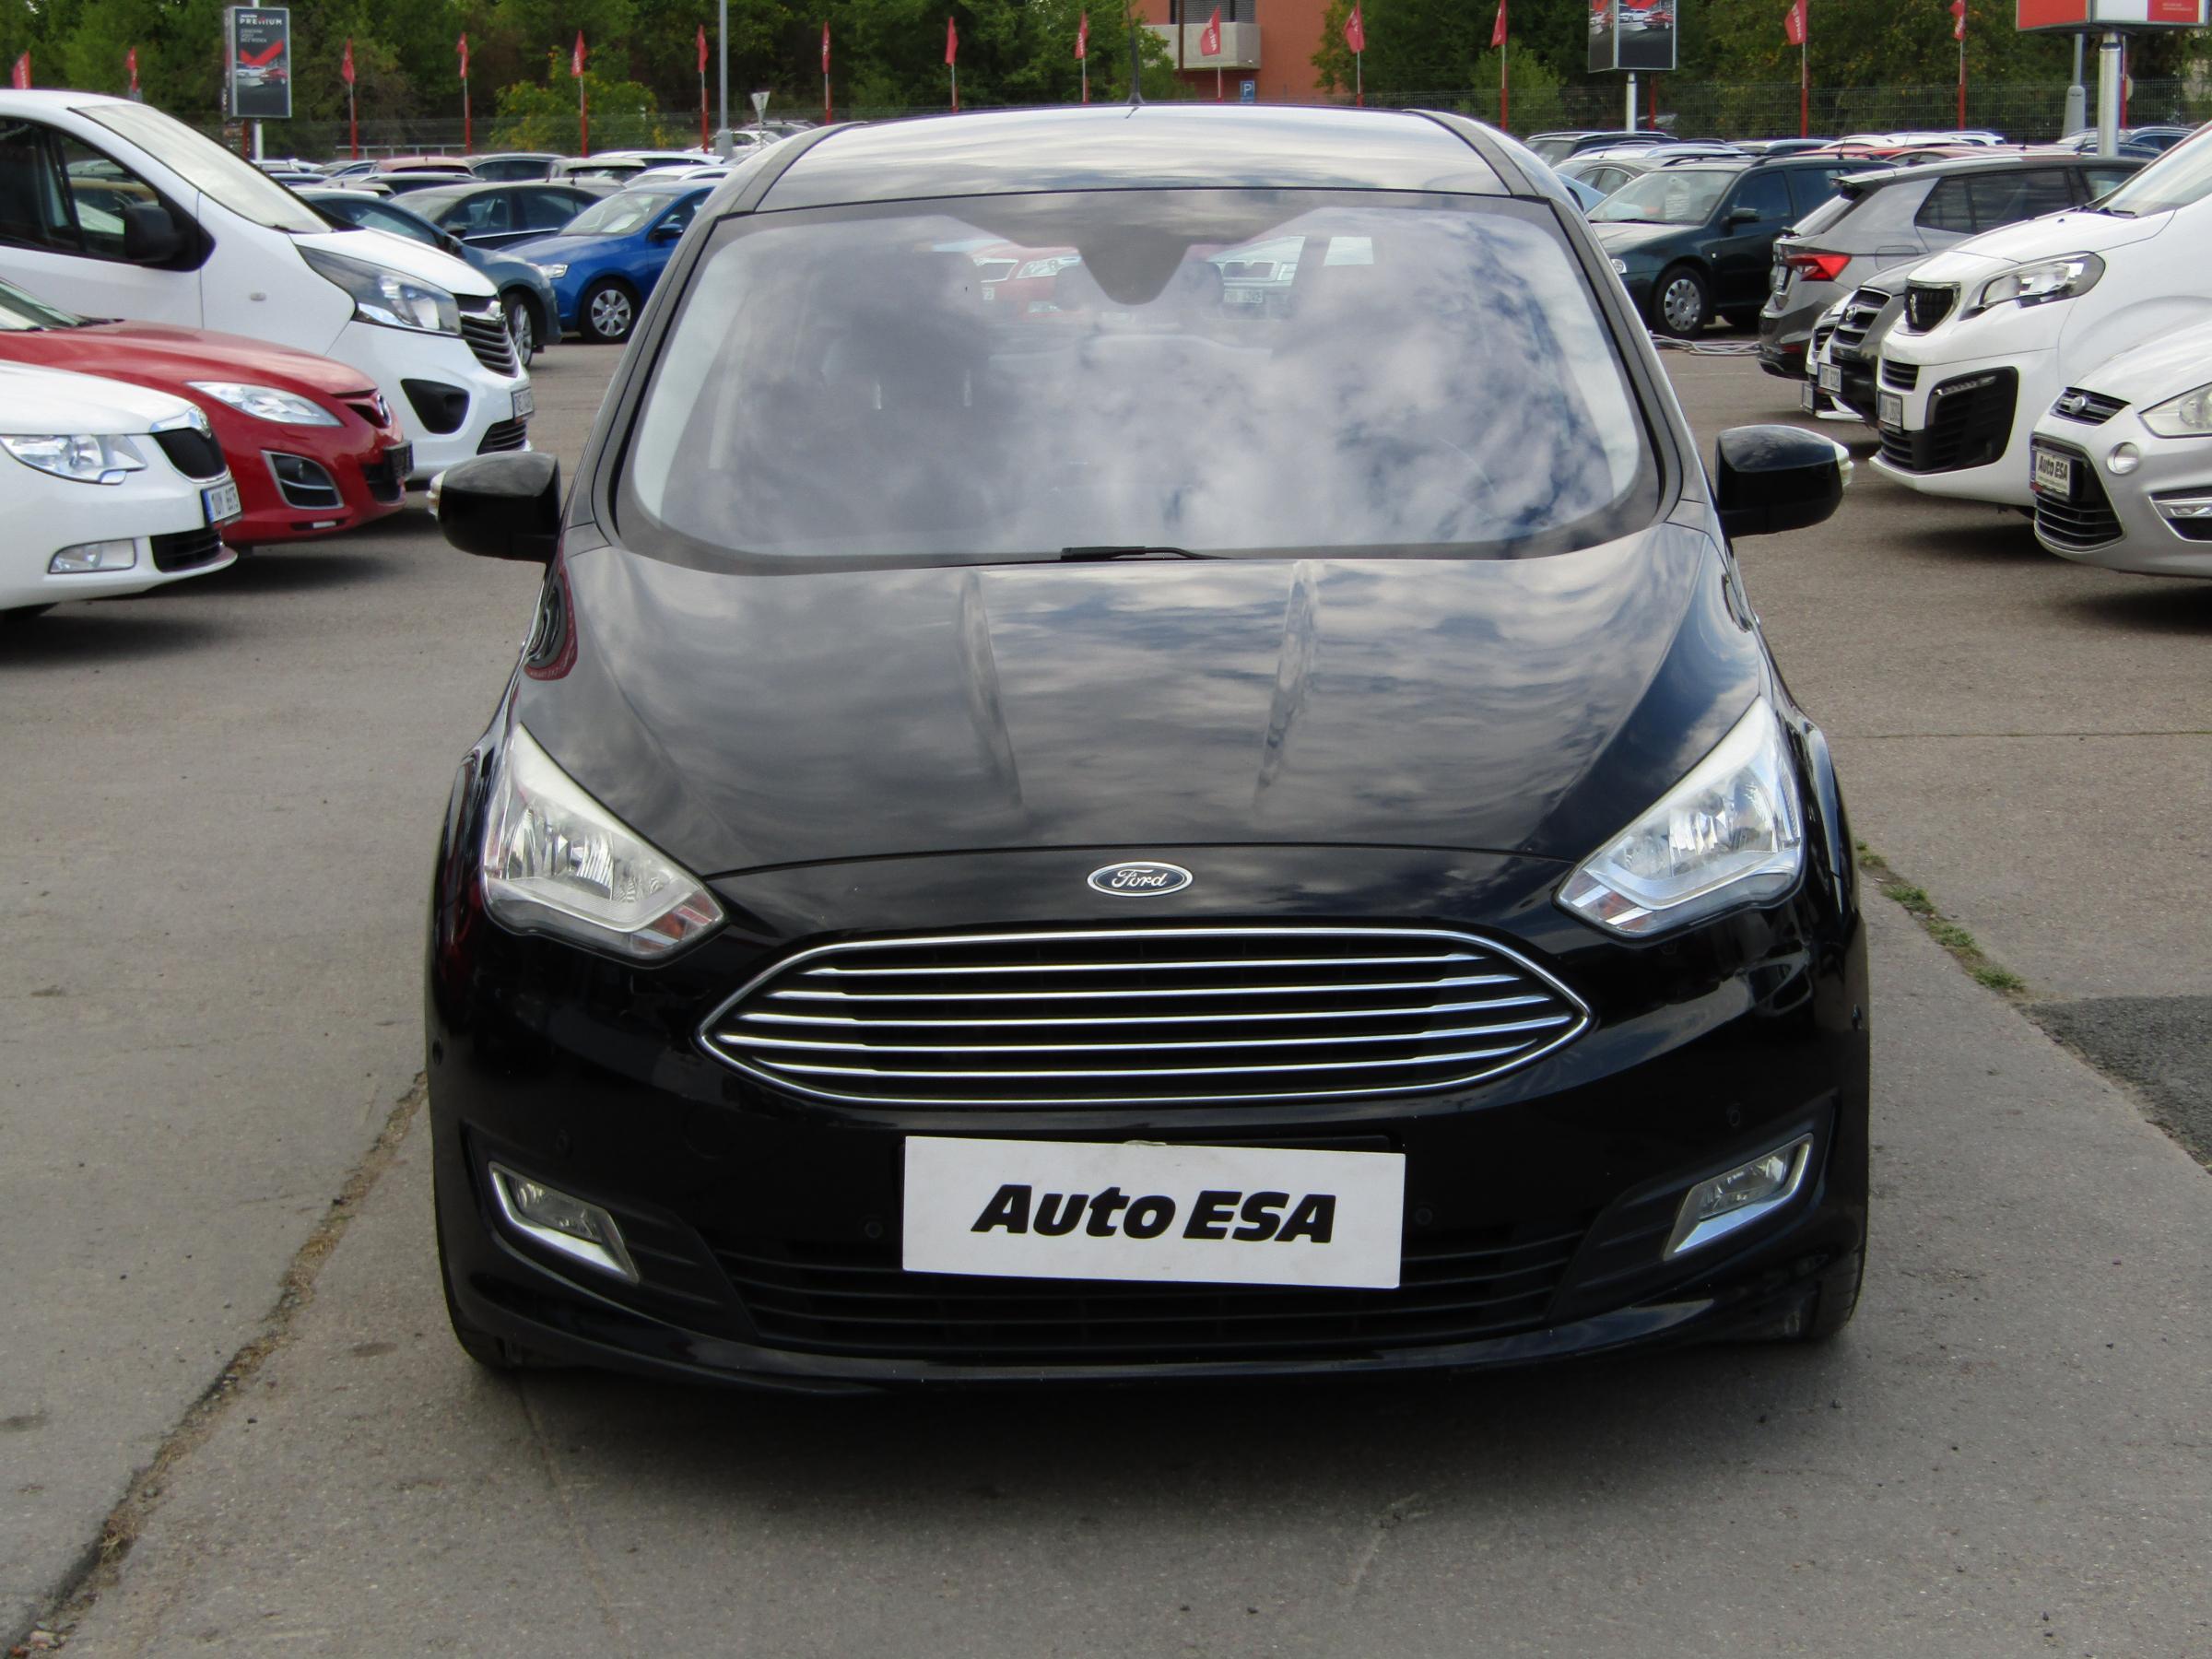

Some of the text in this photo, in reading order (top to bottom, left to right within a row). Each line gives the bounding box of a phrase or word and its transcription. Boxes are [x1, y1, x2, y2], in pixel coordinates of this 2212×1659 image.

[1243, 83, 1252, 97] P
[2038, 455, 2068, 481] Auto ESA
[1112, 868, 1168, 888] Ford
[970, 1184, 1336, 1243] Auto ESA
